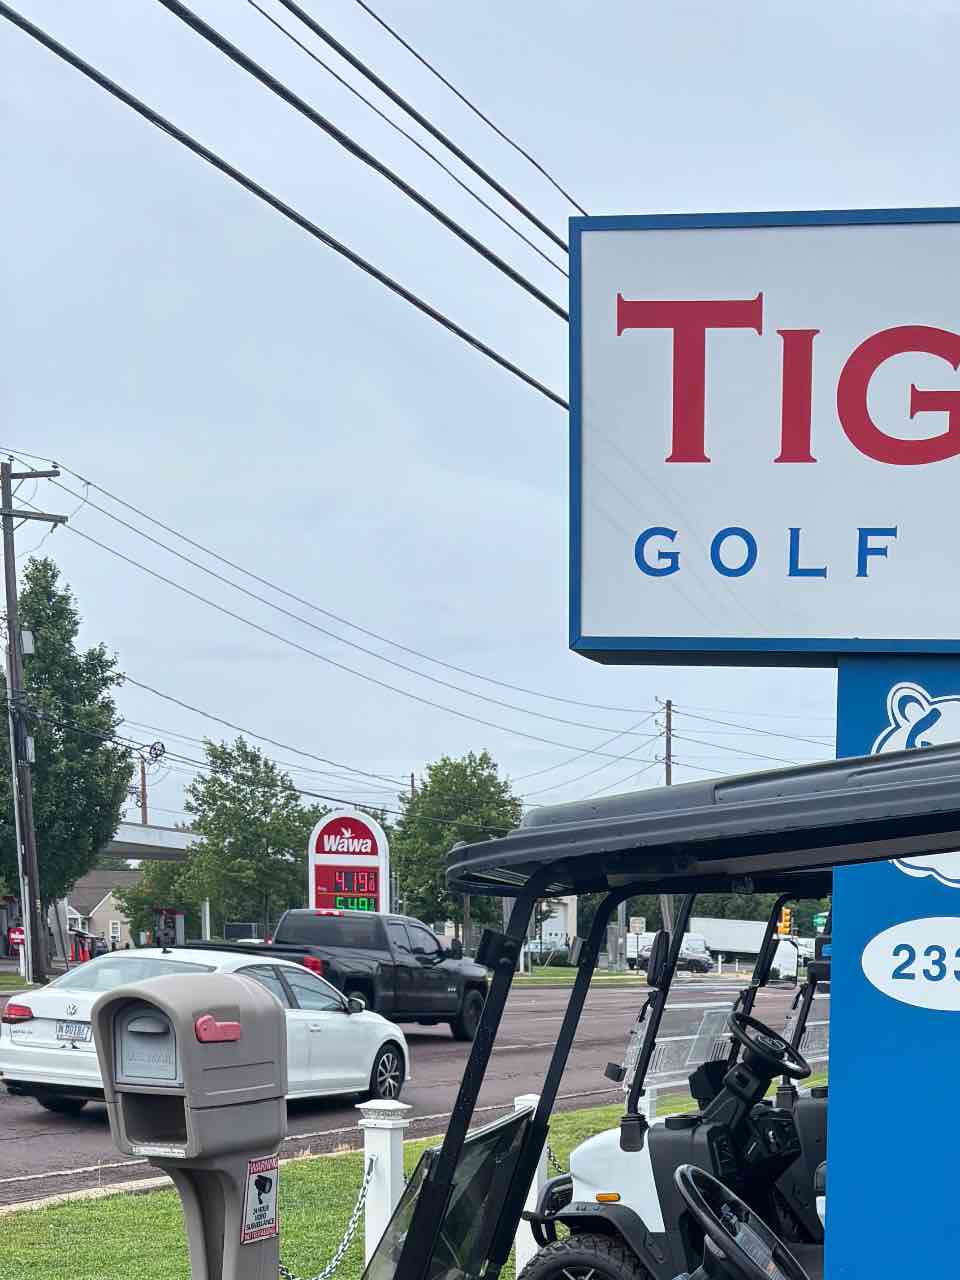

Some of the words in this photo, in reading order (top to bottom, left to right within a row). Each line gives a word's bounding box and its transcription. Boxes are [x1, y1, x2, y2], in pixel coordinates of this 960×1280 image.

[634, 526, 898, 578] GOLF
[323, 833, 372, 853] Wawa
[250, 1157, 278, 1174] WARNING
